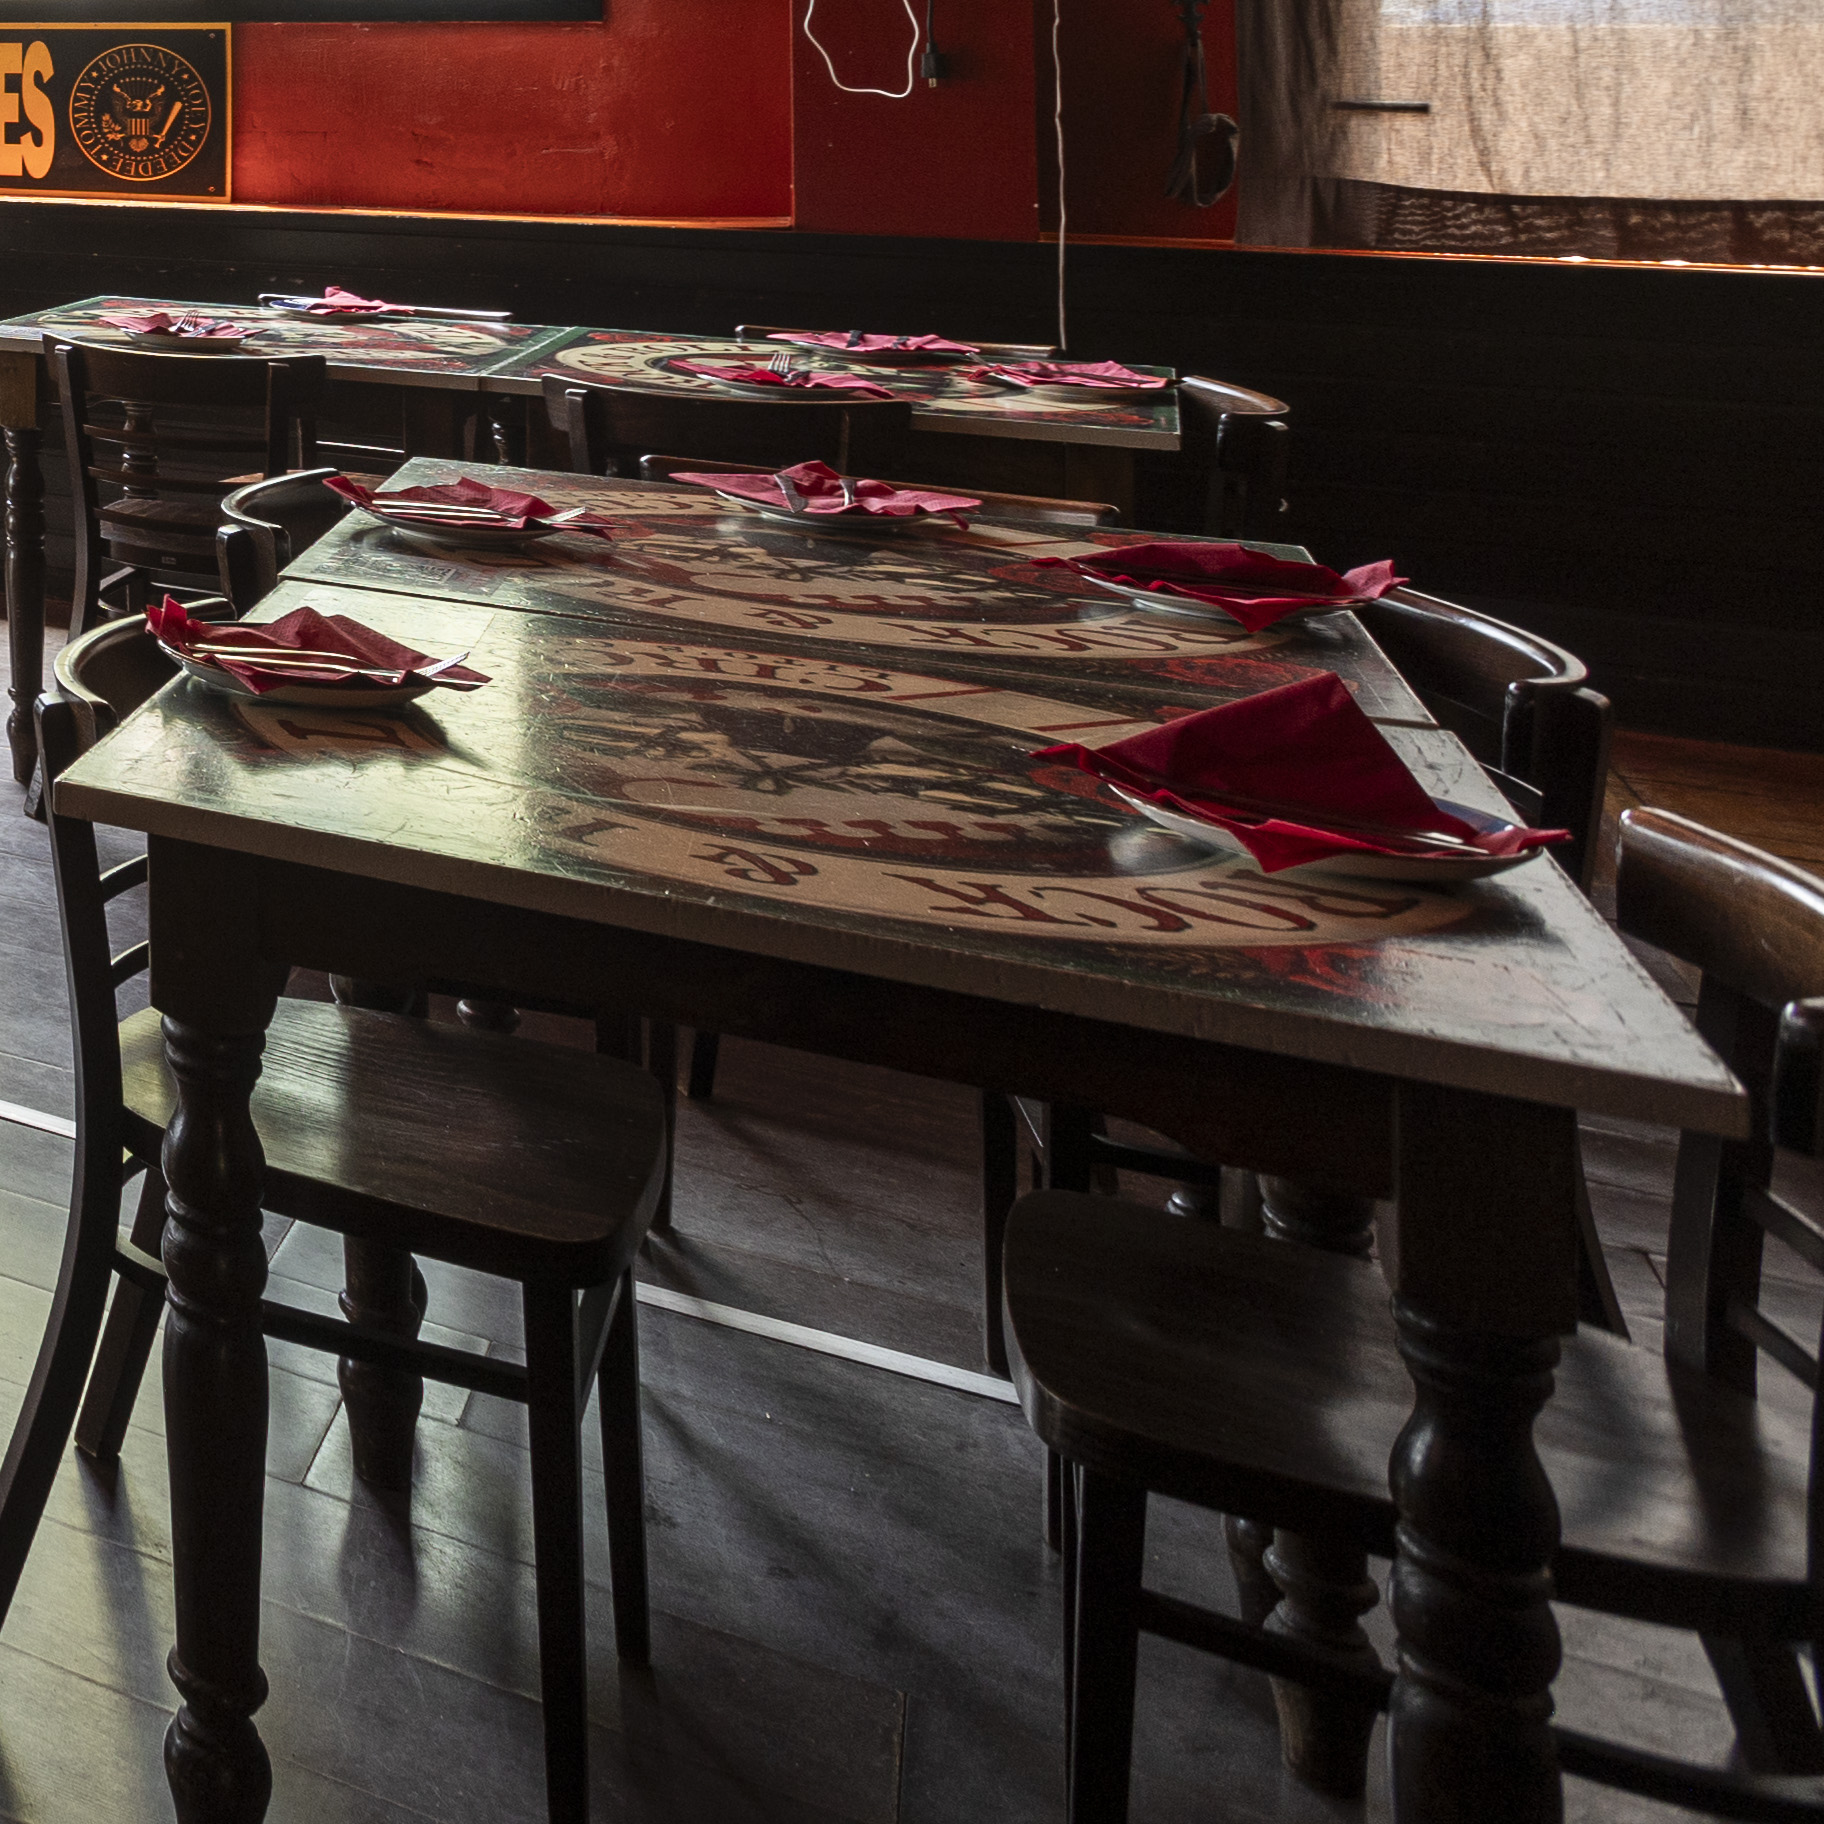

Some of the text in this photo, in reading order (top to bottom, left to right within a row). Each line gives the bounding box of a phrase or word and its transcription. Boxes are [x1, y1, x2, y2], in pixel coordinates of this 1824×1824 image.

[98, 48, 187, 74] JOHNNY
[74, 75, 103, 157] TOMMY
[882, 869, 1420, 935] ROCK
